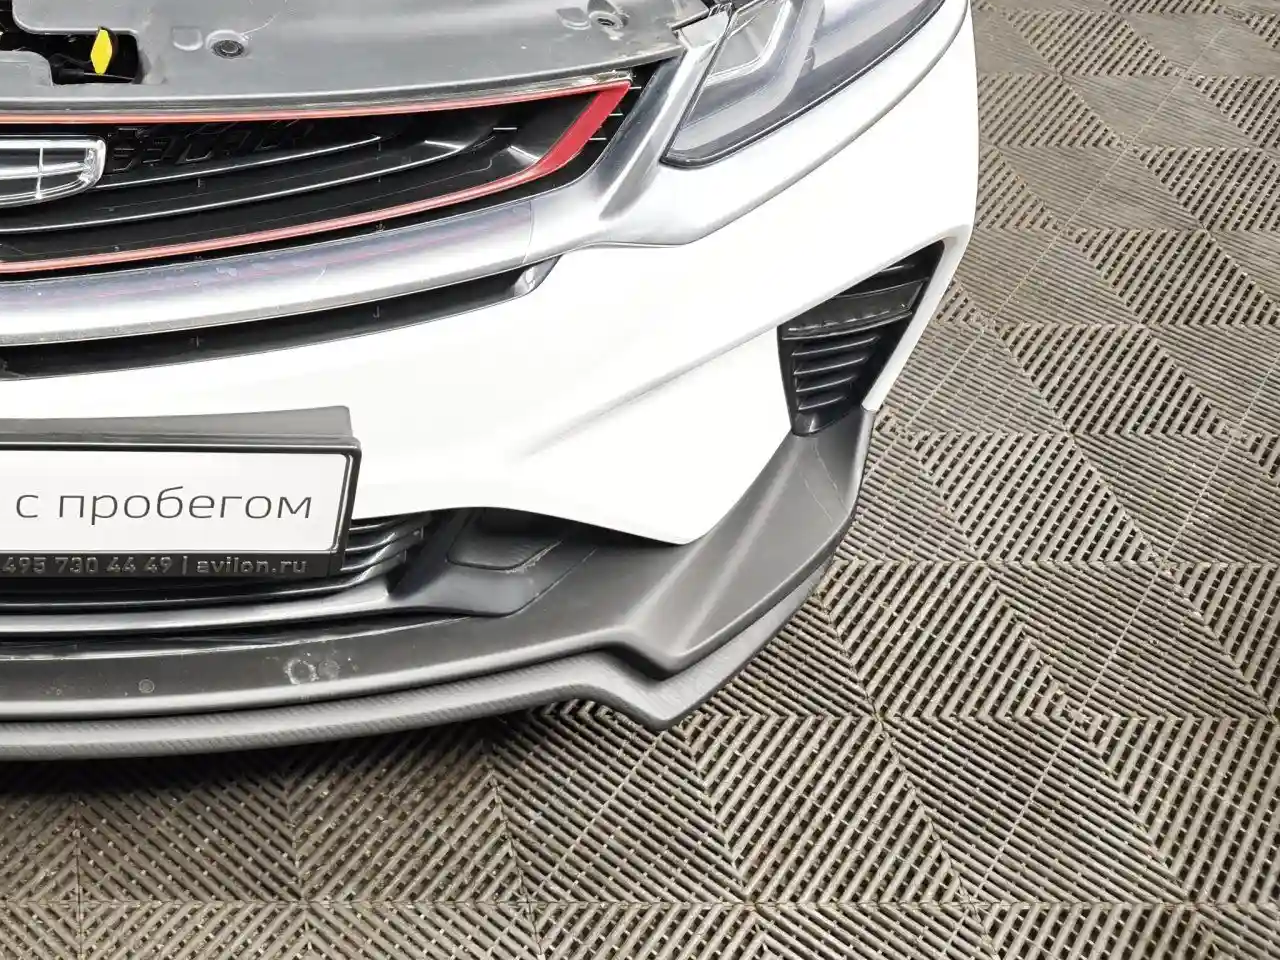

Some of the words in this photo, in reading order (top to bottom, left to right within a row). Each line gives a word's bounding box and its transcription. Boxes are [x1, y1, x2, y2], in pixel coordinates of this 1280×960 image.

[16, 494, 39, 518] с
[59, 485, 312, 525] пробегом
[2, 556, 46, 573] 495
[54, 556, 99, 574] 730
[106, 556, 136, 573] 44
[144, 556, 171, 573] 49
[197, 556, 307, 574] avilon.ru
